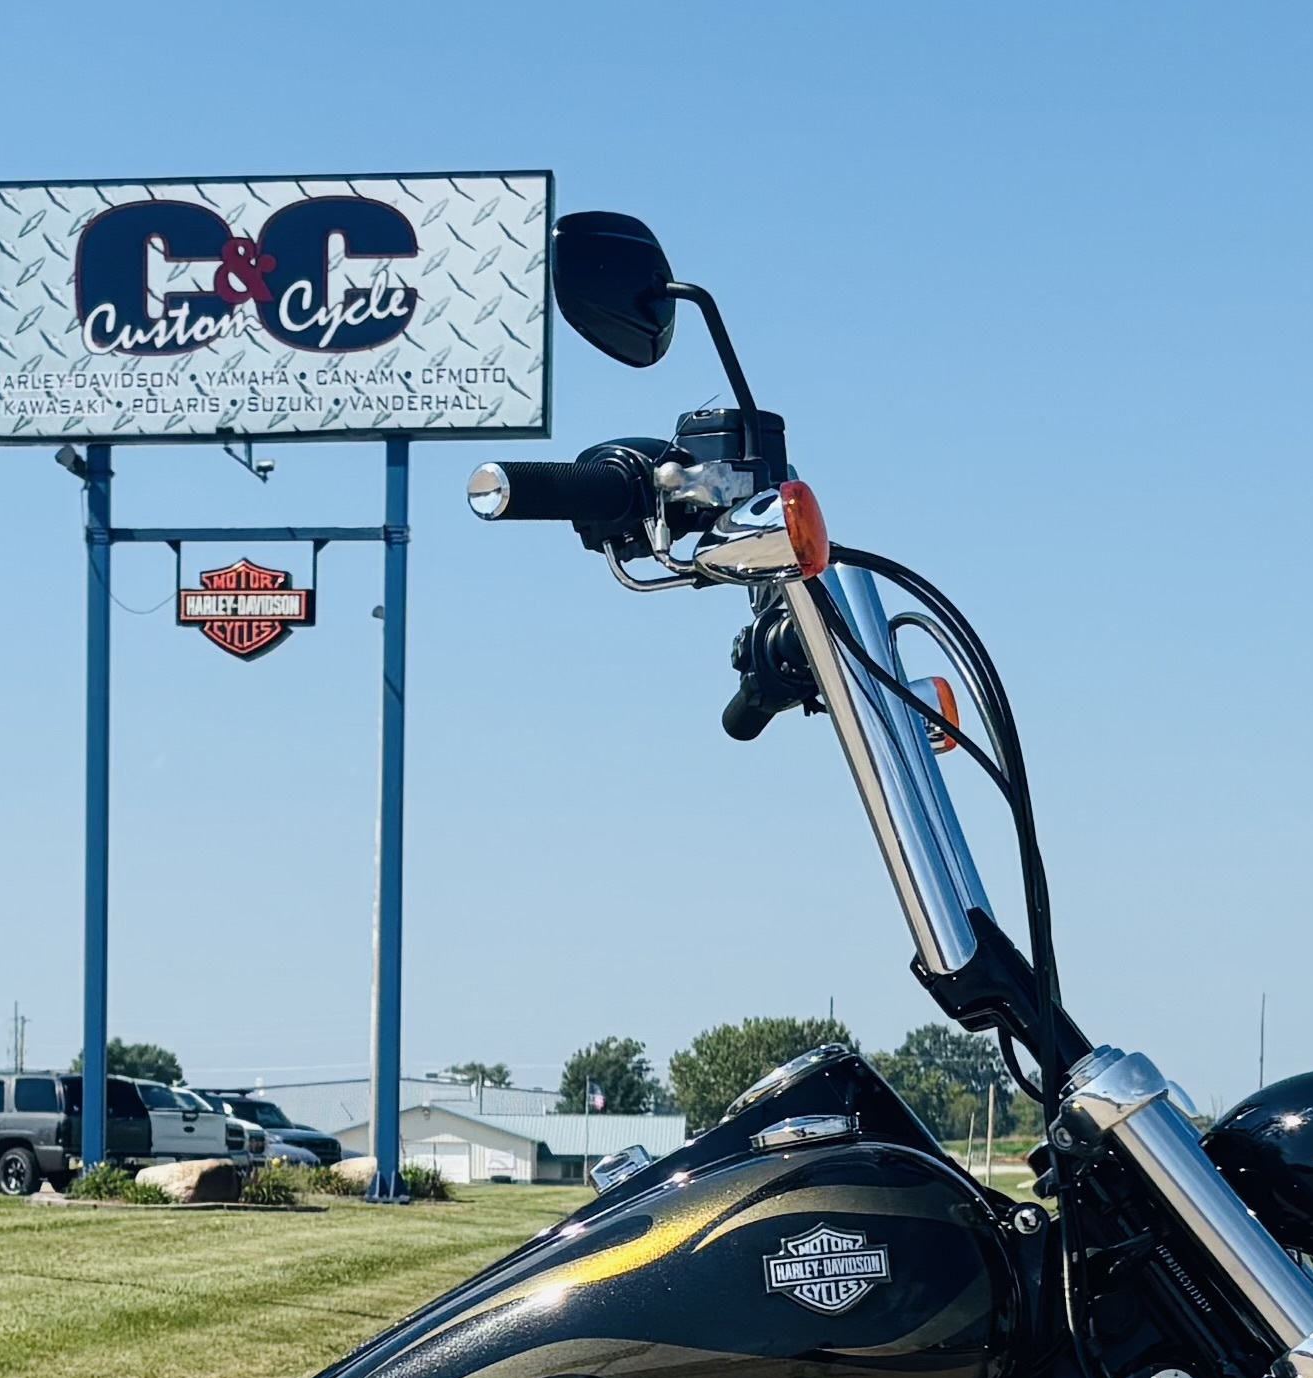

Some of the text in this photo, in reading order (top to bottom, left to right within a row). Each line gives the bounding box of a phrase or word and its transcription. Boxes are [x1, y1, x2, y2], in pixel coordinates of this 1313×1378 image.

[82, 269, 410, 356] Custom Cycle
[205, 370, 289, 387] YAMAHA
[315, 369, 395, 386] CAN-AM
[421, 367, 506, 384] CFMOTO
[3, 394, 489, 416] KAWASAKI POLARIS SUZUKI VANDERHALL
[213, 568, 273, 589] MOTOR
[186, 595, 301, 616] HARLEY-DAVIDSON
[212, 621, 272, 648] CYCLES
[798, 1233, 855, 1256] MOTOR
[775, 1254, 881, 1282] HARLEY-DAVIDSON
[801, 1280, 859, 1306] CYCLES
